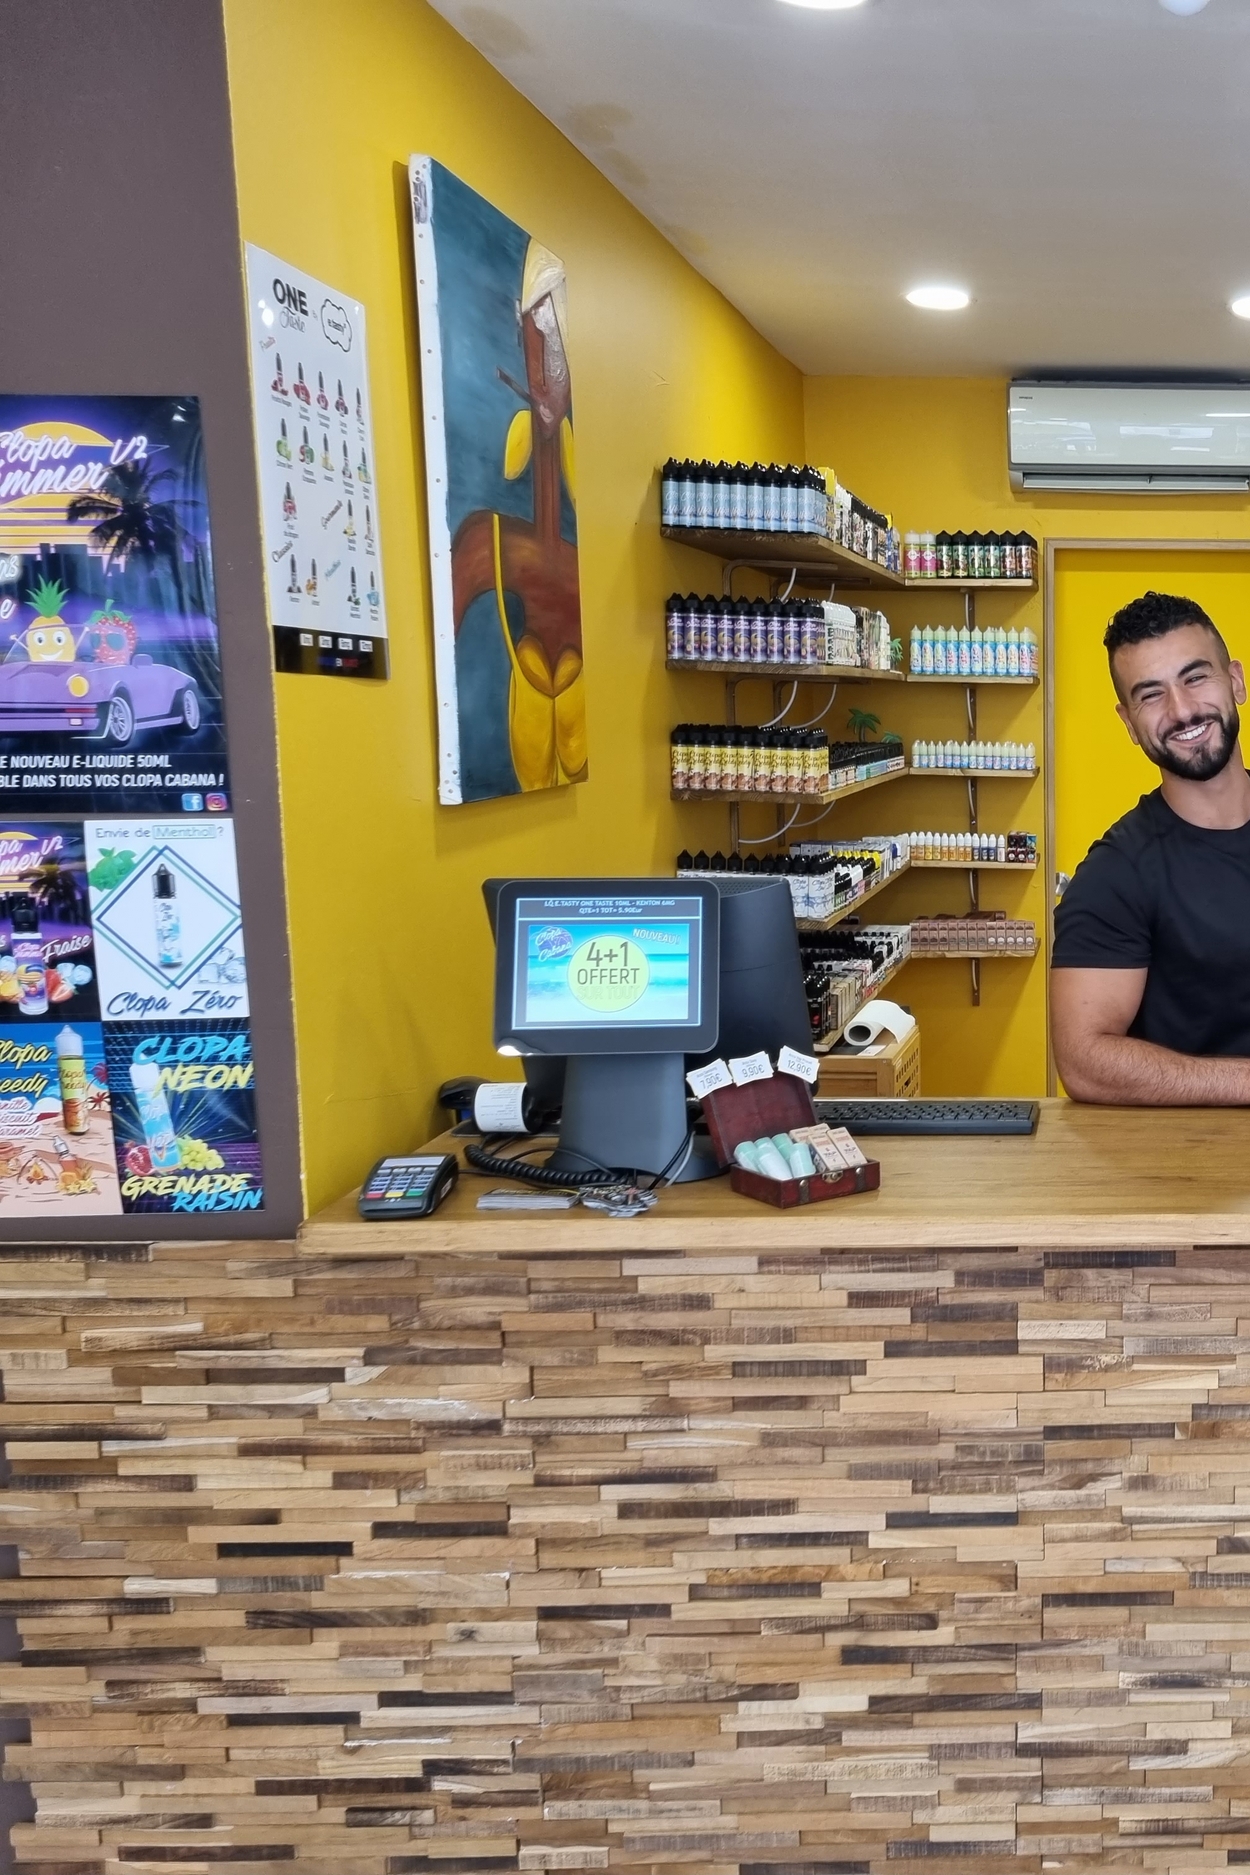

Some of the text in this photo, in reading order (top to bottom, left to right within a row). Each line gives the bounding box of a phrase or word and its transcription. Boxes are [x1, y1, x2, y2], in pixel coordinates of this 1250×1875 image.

[273, 278, 309, 317] ONE
[110, 436, 148, 465] V2
[10, 755, 70, 768] NOUVEAU
[72, 755, 135, 768] E-LIQUIDE
[137, 755, 173, 767] 50ML
[23, 775, 56, 788] DANS
[59, 774, 91, 787] TOUS
[94, 774, 120, 787] VOS
[122, 774, 163, 787] CLOPA
[165, 773, 217, 786] CABANA
[95, 826, 224, 839] Envie de Menthol ?
[40, 933, 93, 963] Fraise
[586, 941, 629, 967] 4+1
[577, 968, 640, 985] OFFERT
[107, 990, 243, 1018] Clopa Zéro
[577, 985, 641, 1000] SUR TOUT
[132, 1034, 251, 1065] CLOPA
[152, 1061, 254, 1099] NEON
[741, 1064, 765, 1079] 9,90€
[787, 1060, 812, 1076] 12,90€
[0, 1073, 49, 1099] eedy
[700, 1073, 723, 1089] 7,90€
[121, 1173, 253, 1201] GRENADE
[171, 1188, 263, 1213] RAISIN
